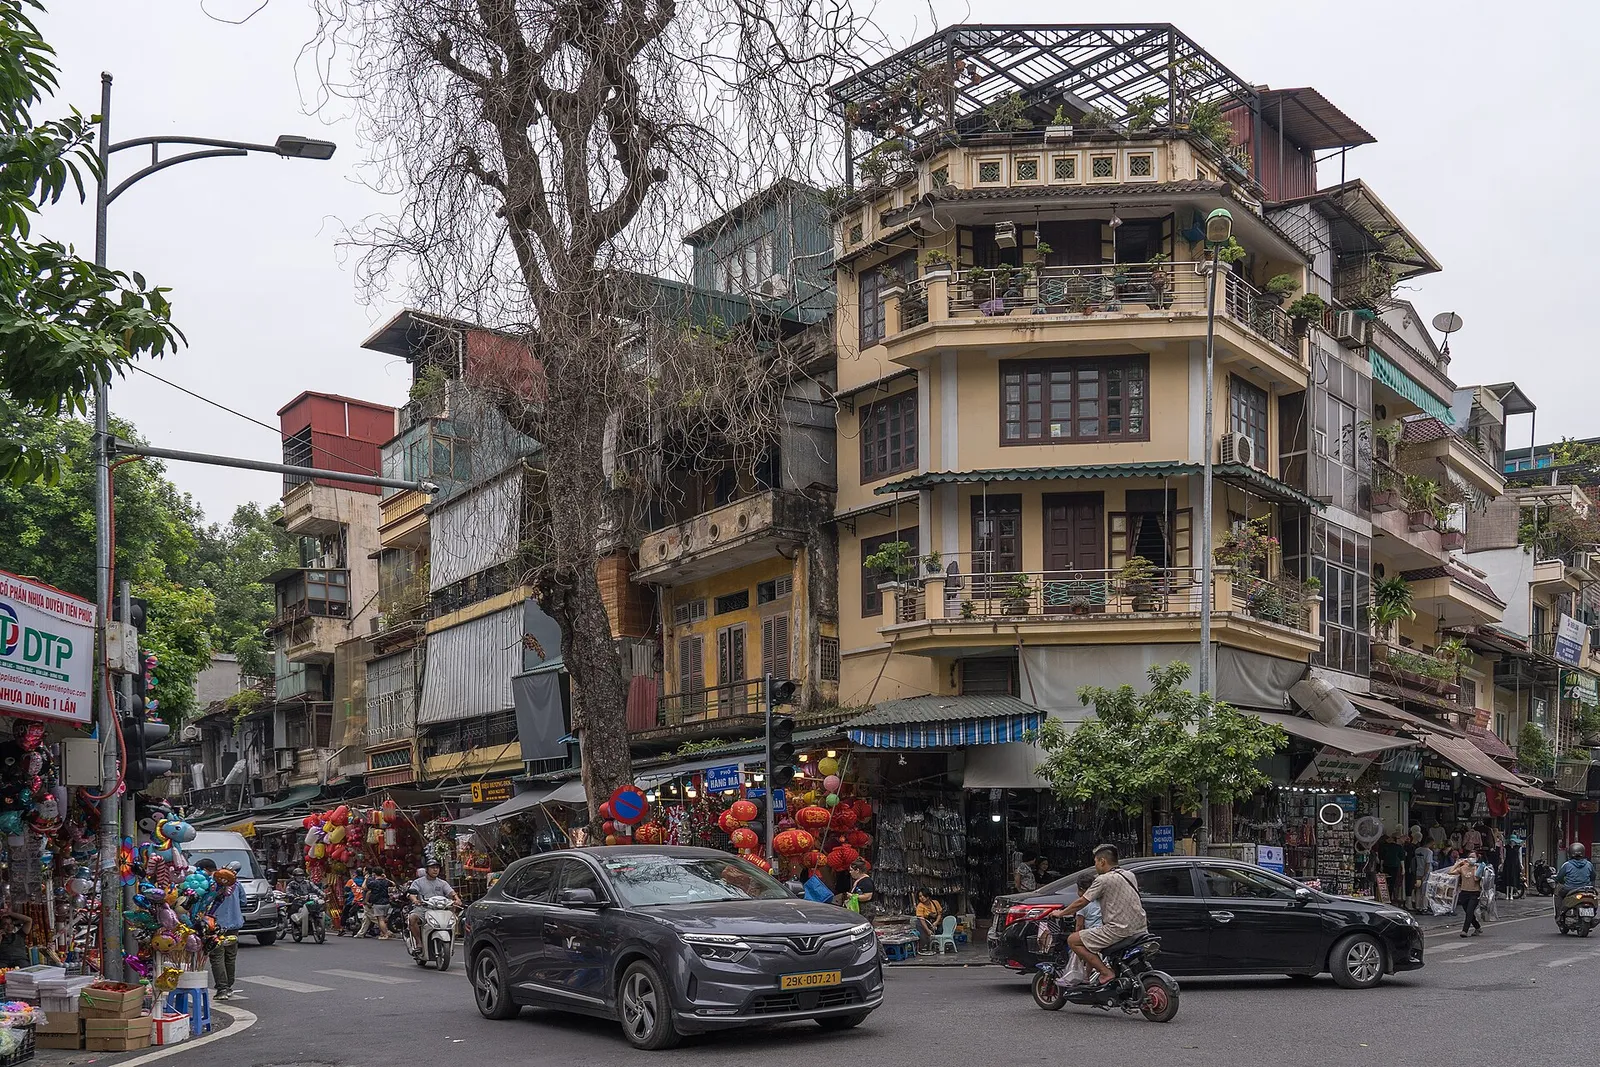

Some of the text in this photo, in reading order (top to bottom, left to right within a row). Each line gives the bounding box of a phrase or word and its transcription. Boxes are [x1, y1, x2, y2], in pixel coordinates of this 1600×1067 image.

[23, 627, 73, 669] DTP
[39, 681, 86, 698] duyentienphuc.com
[25, 691, 50, 709] DÙNG
[52, 698, 57, 710] 1
[710, 775, 738, 789] HÀNG MÃ
[786, 973, 837, 987] 29K-007.21
